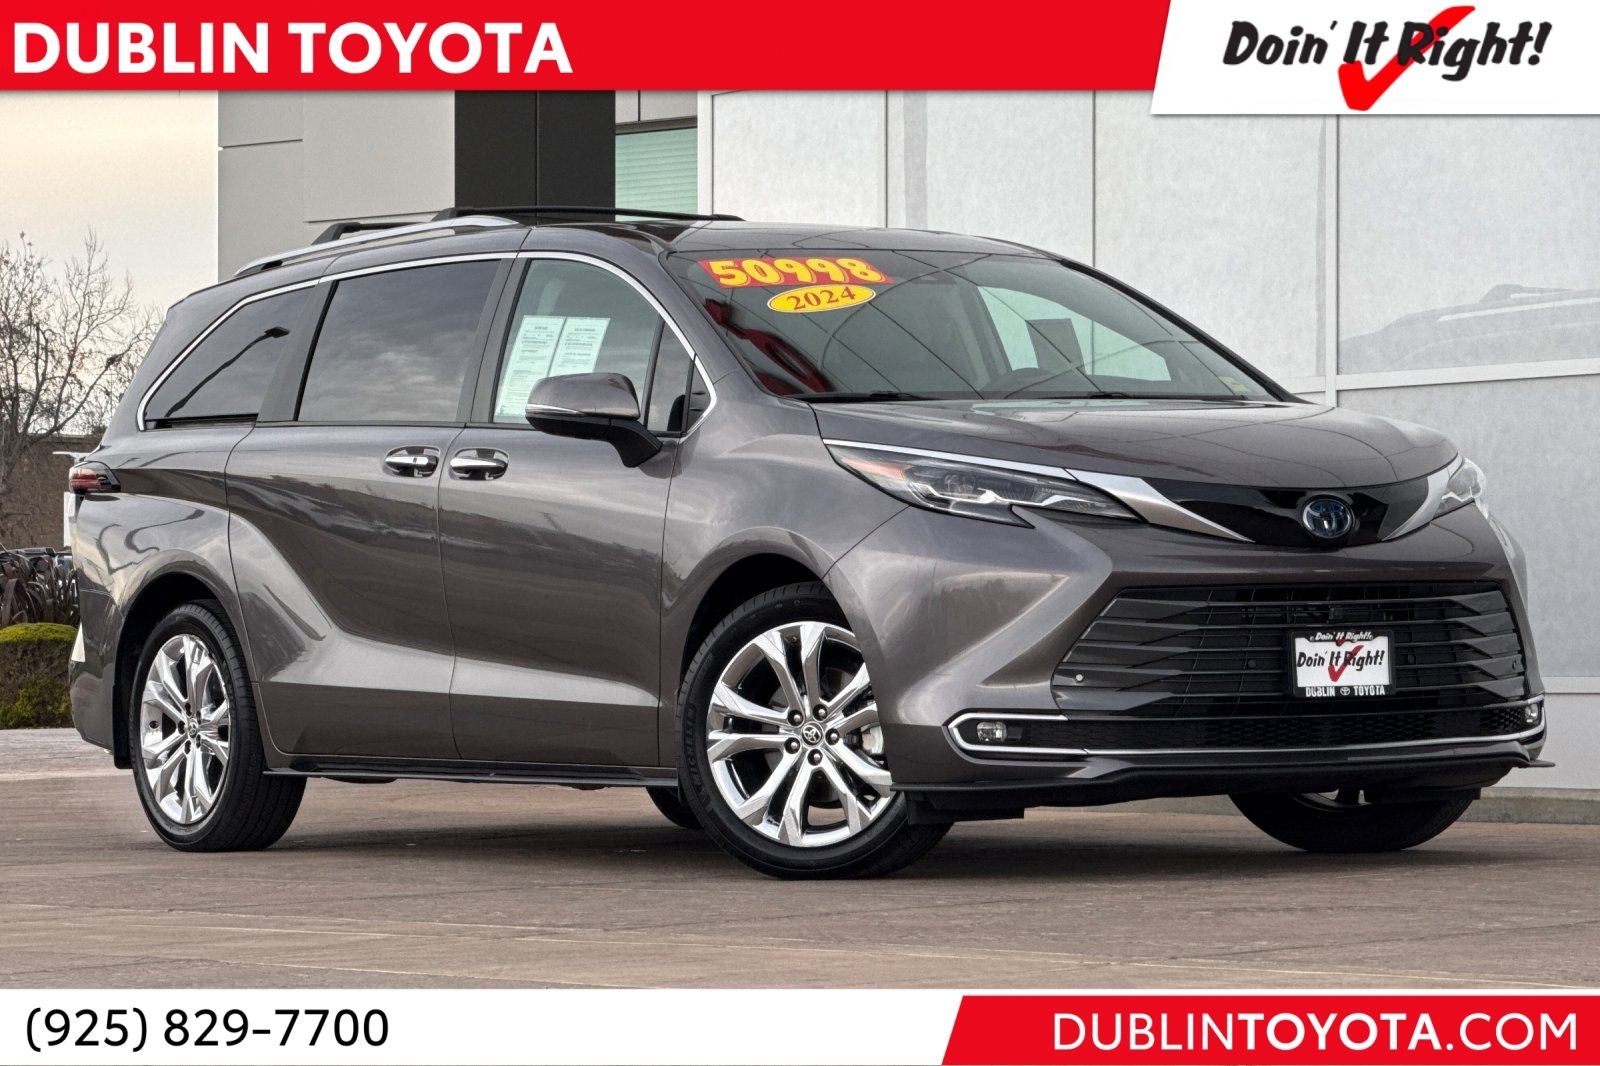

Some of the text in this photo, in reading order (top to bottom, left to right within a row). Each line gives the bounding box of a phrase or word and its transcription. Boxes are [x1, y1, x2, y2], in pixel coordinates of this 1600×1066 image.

[708, 257, 887, 287] 50998
[786, 286, 857, 311] 2024
[1296, 649, 1386, 672] Doin' It Right!
[1305, 685, 1386, 698] DUBLIN TOYOTA
[685, 705, 702, 786] MICHELIN
